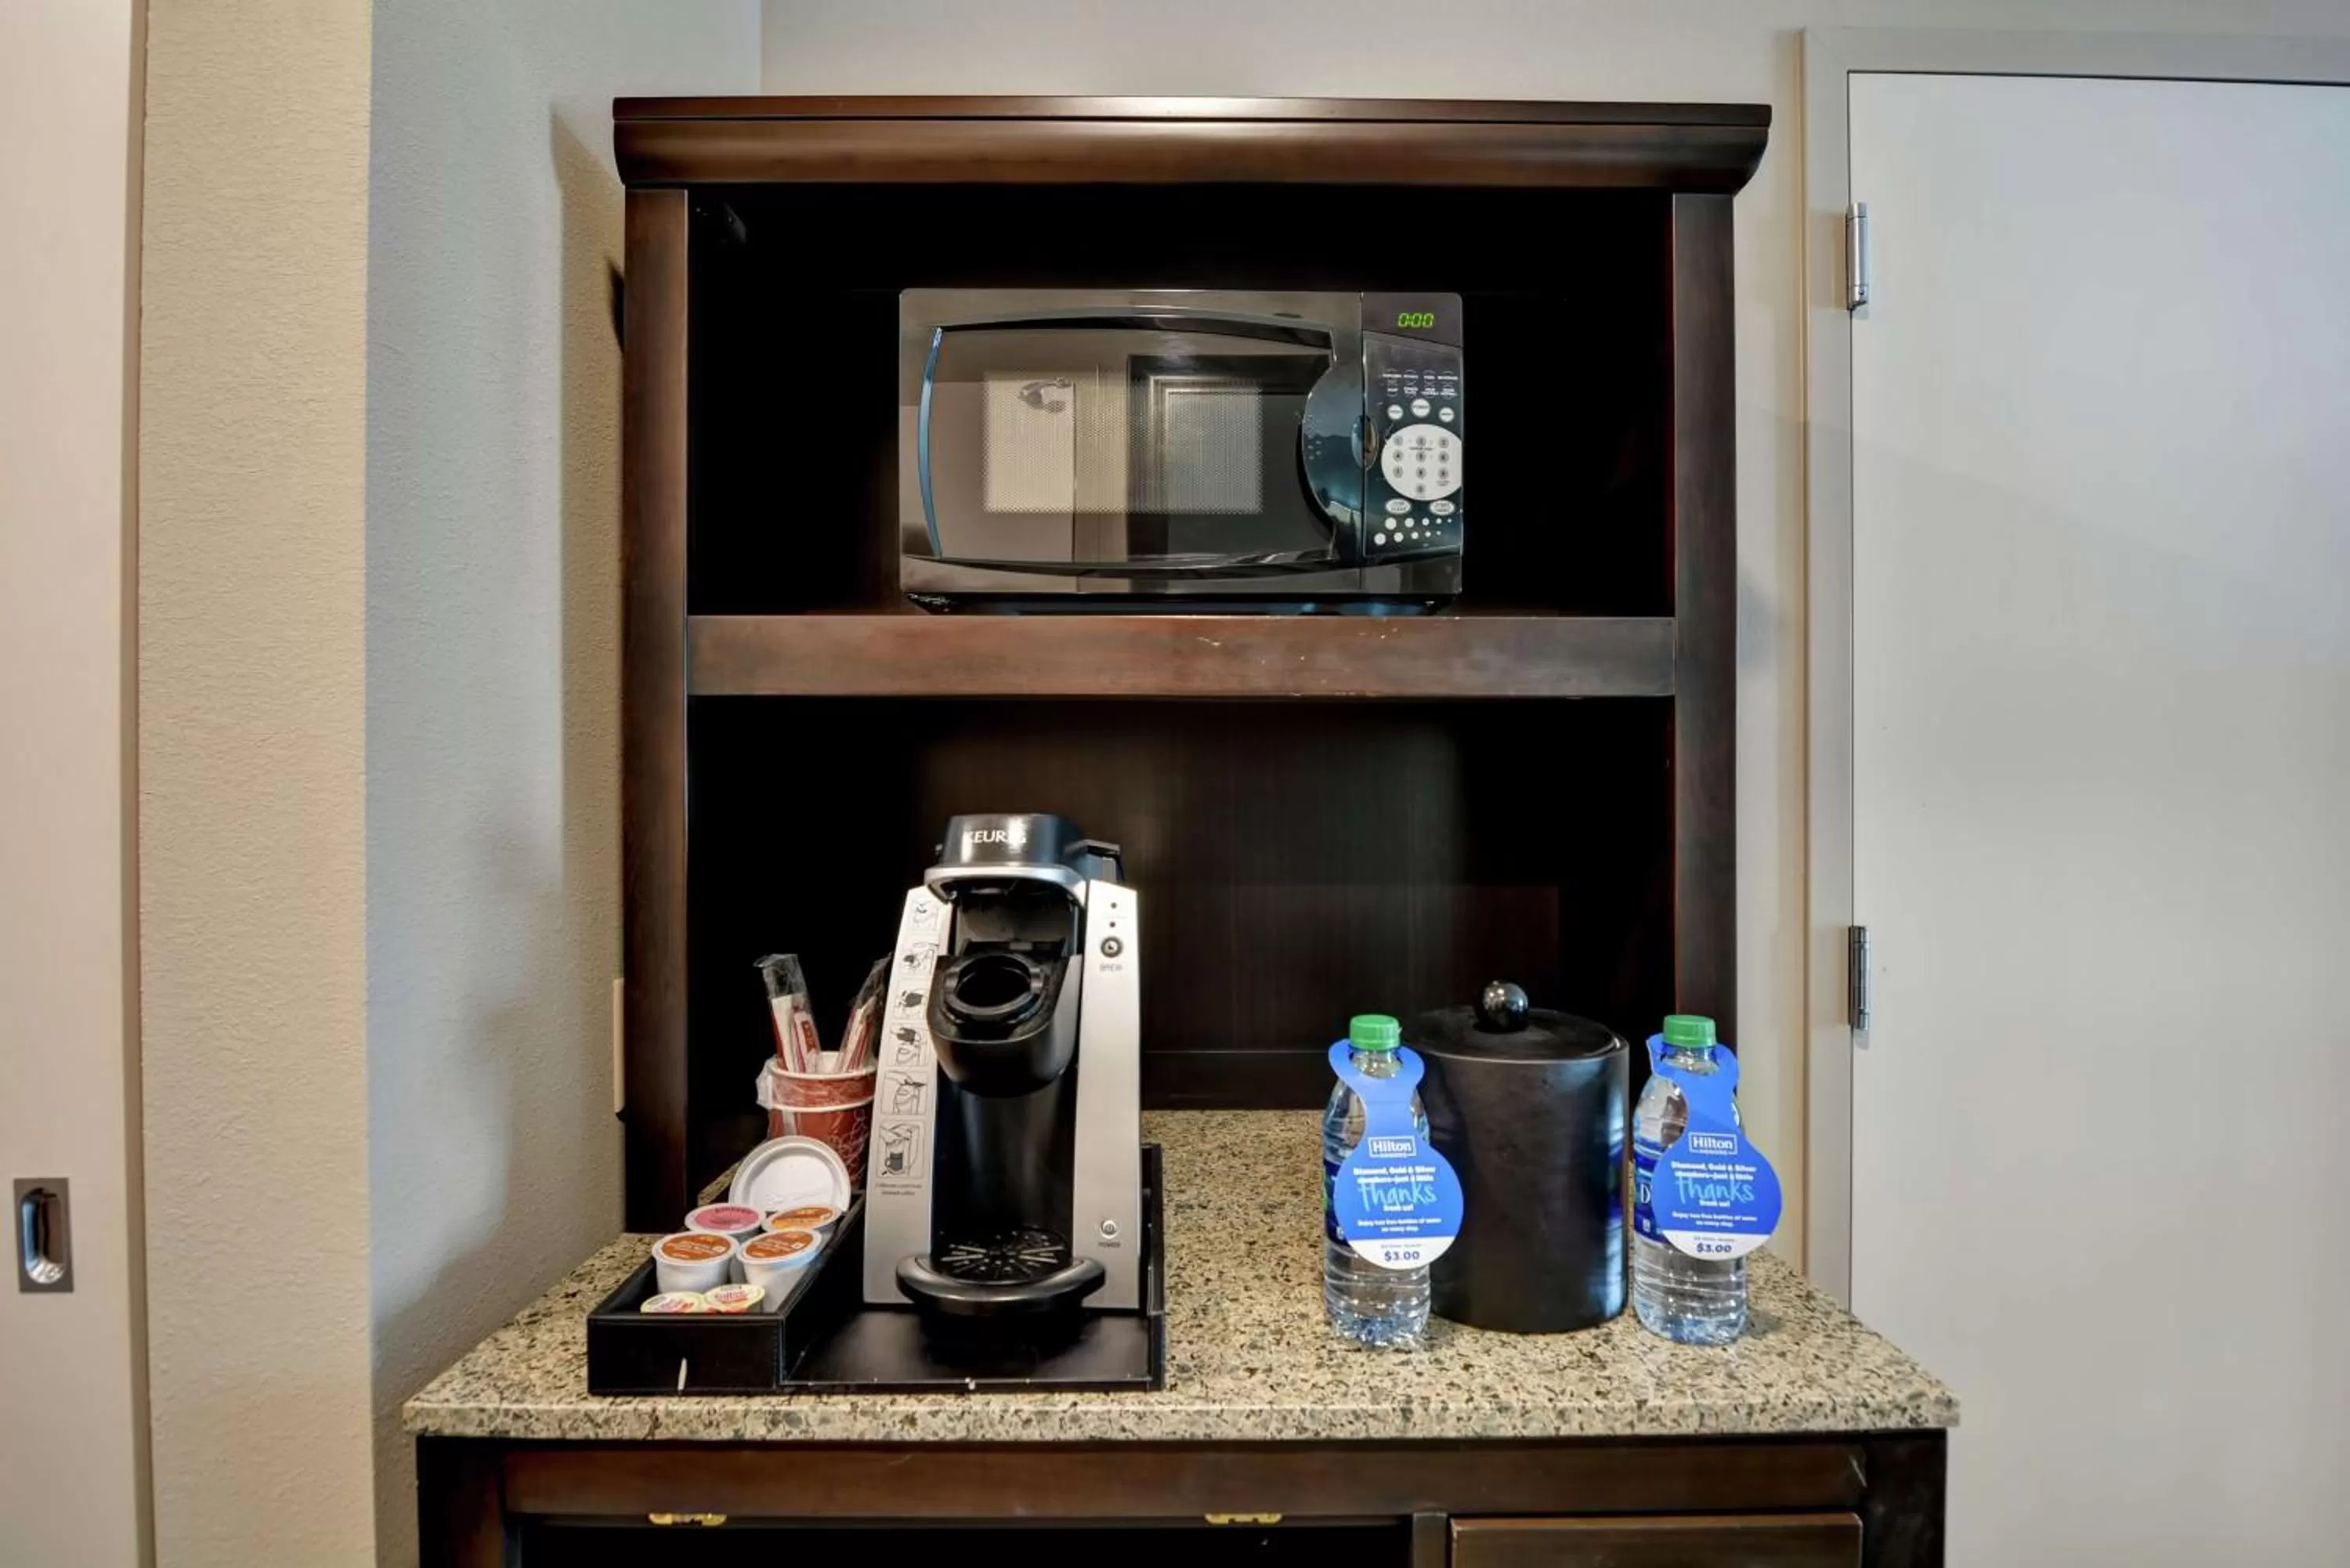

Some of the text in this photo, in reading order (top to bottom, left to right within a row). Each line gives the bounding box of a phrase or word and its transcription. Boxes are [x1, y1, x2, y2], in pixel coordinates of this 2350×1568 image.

[1398, 313, 1434, 327] 0:00
[1372, 1140, 1412, 1153] Hilton
[1693, 1136, 1734, 1150] Hilton
[1696, 1243, 1733, 1254] $3.00
[1384, 1251, 1420, 1262] $3.00
